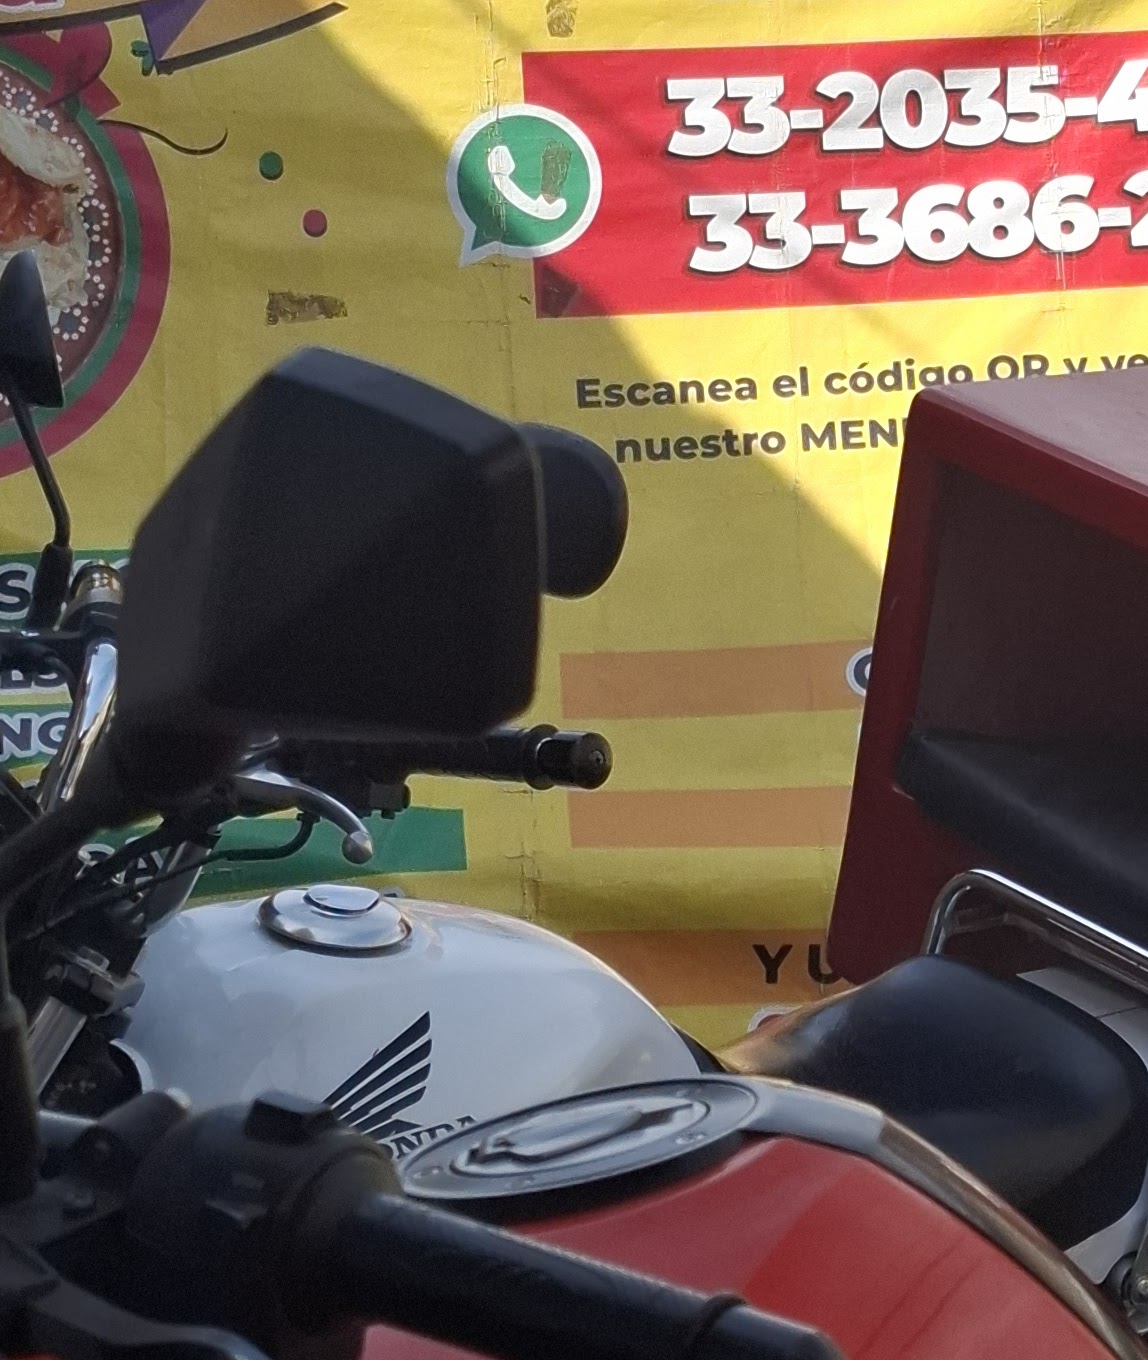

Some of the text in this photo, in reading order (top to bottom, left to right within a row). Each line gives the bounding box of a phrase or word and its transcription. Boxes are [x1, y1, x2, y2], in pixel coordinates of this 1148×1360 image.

[575, 374, 758, 409] Escanea
[772, 365, 809, 398] el
[824, 358, 974, 396] código
[616, 417, 909, 463] nuestro MEN
